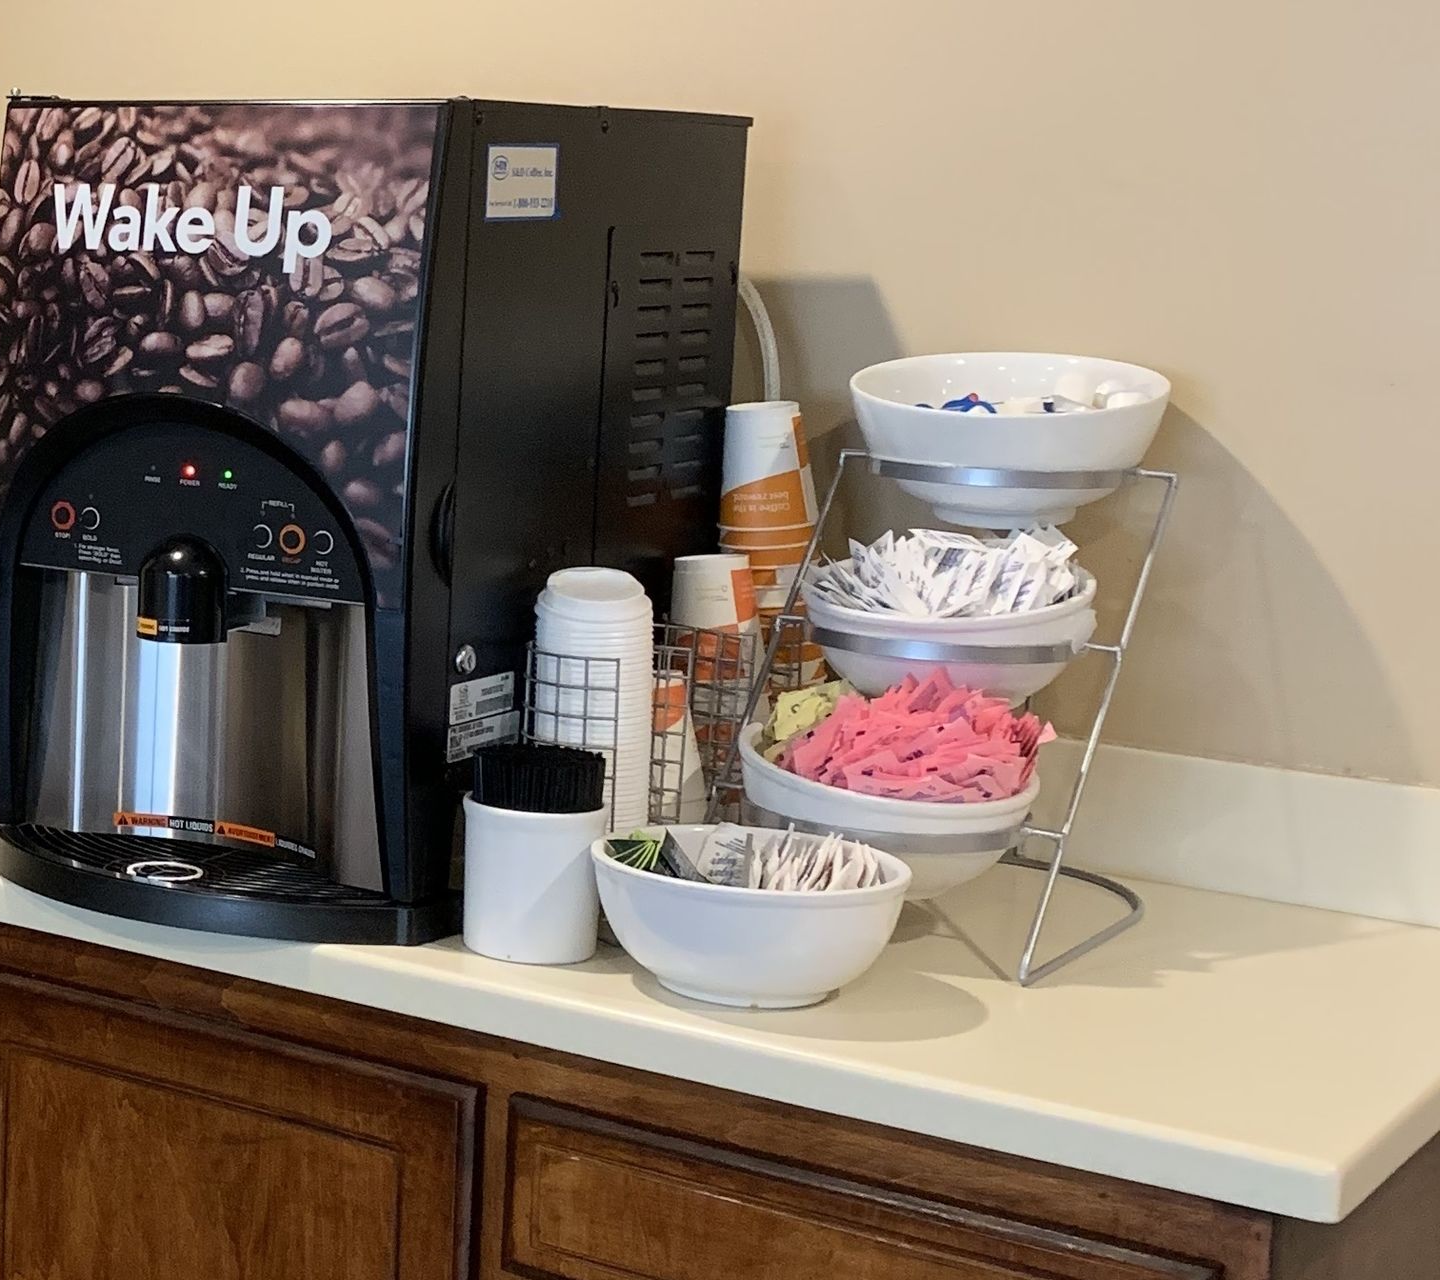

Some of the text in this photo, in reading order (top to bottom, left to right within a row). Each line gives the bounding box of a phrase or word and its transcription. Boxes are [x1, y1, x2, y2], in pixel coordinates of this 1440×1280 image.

[54, 183, 332, 273] Wake Up
[218, 482, 238, 490] READY
[248, 553, 275, 561] REGULAR
[130, 816, 167, 828] WARNING
[169, 819, 185, 828] HOT
[185, 821, 213, 833] LIQUIDS
